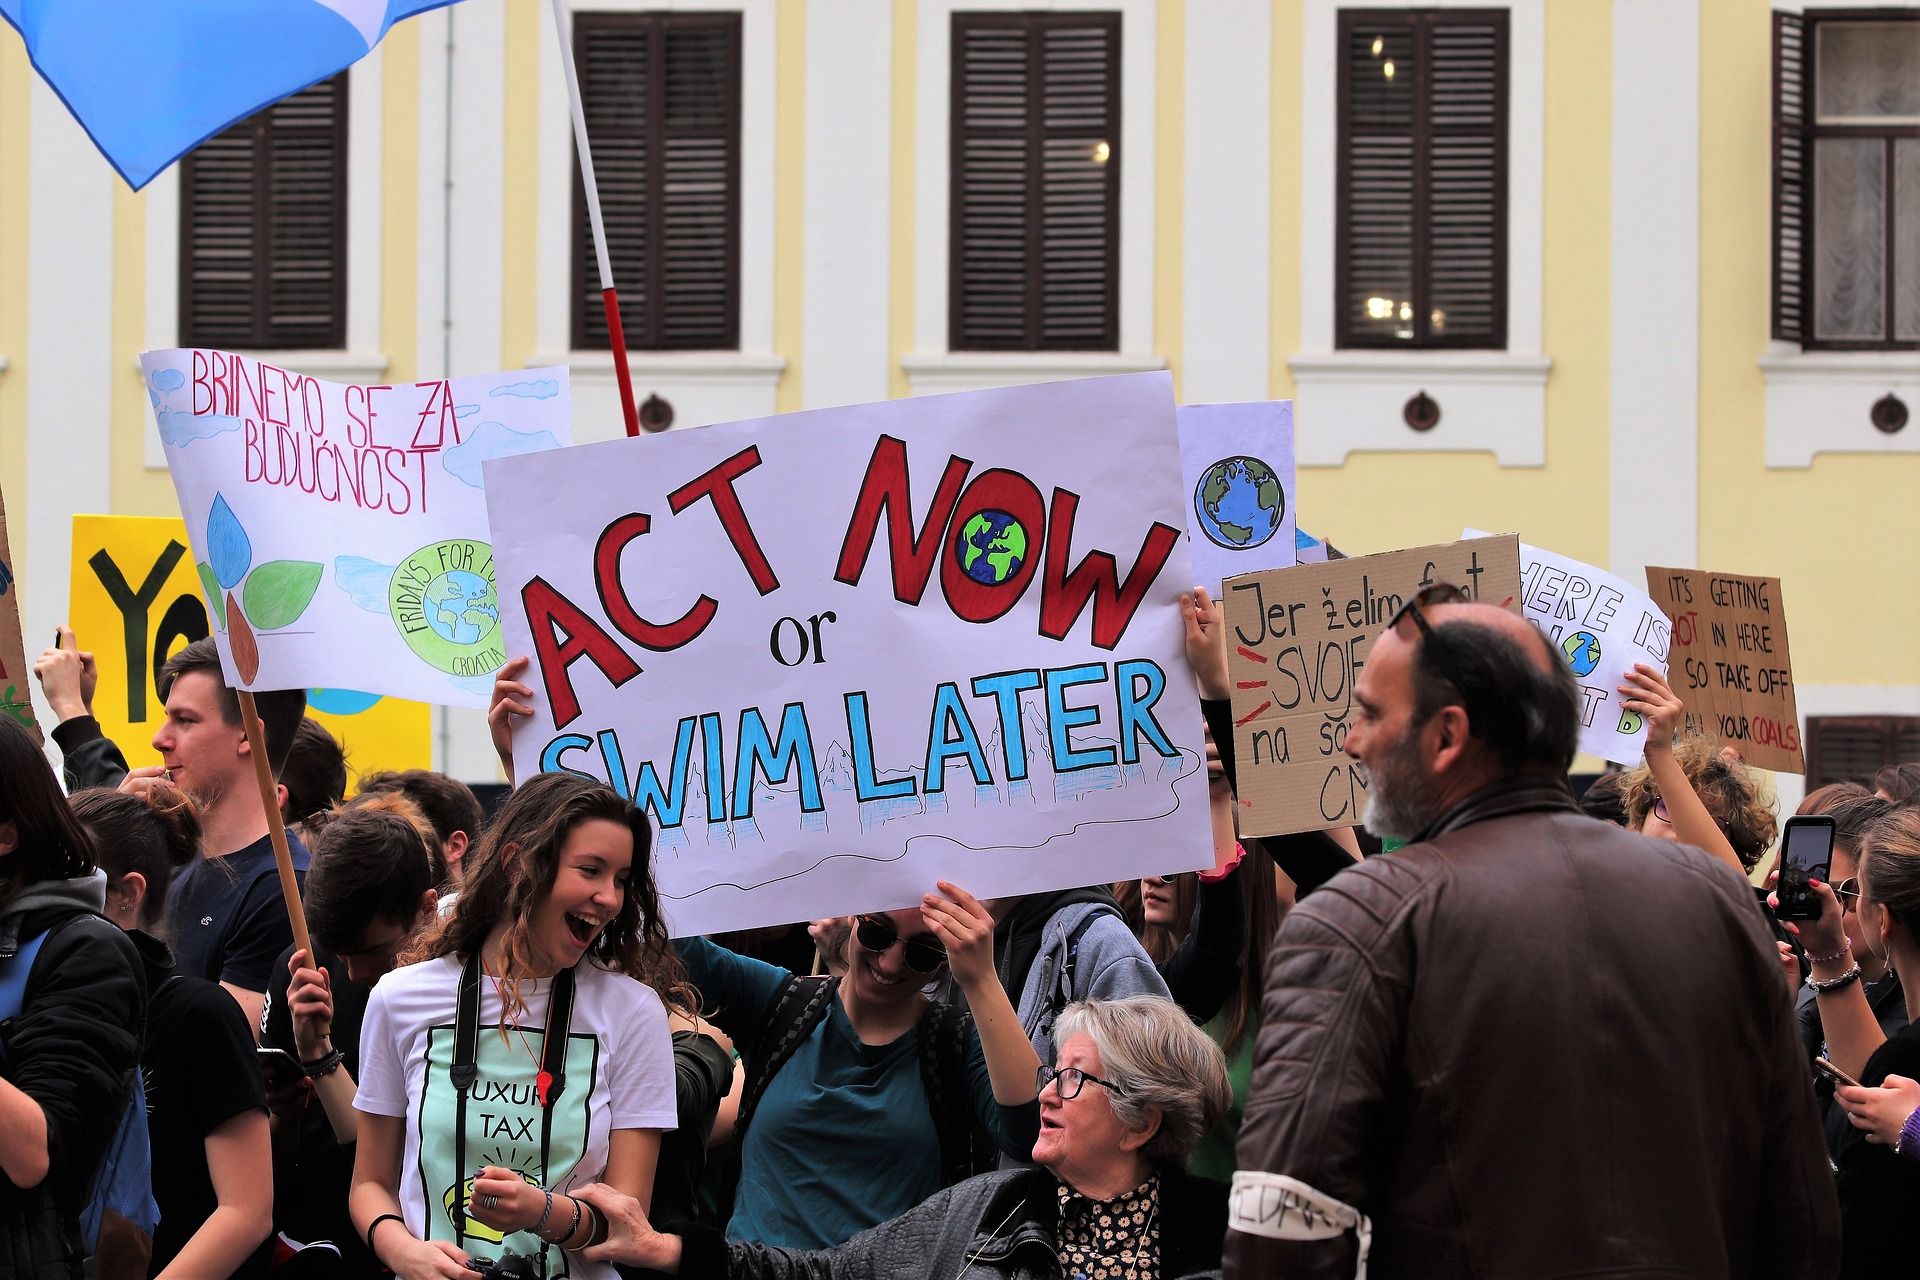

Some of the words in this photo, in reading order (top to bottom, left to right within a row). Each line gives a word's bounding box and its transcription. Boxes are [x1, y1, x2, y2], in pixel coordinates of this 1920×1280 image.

[193, 351, 324, 437] BRINEMO
[345, 385, 393, 450] SE
[411, 380, 461, 450] ZA
[245, 417, 440, 515] BUDUĆNOST
[397, 559, 432, 634] FRIDAYS
[437, 543, 475, 571] FOR
[520, 445, 780, 731] ACT
[834, 434, 1181, 651] NOW
[1668, 576, 1693, 603] IT'S
[1710, 578, 1770, 614] GETTING
[1232, 582, 1305, 646] Jer
[1321, 575, 1403, 631] želim
[1666, 611, 1698, 647] HOT
[1711, 622, 1727, 648] IN
[1735, 623, 1773, 653] HERE
[452, 647, 507, 676] CROATIA
[769, 609, 837, 668] or
[1633, 610, 1671, 664] IS
[1685, 657, 1709, 689] SO
[1715, 662, 1753, 693] TAKE
[1758, 668, 1789, 701] OFF
[539, 702, 825, 829] SWIM
[844, 660, 1182, 803] LATER
[1252, 727, 1290, 765] na
[1716, 712, 1752, 740] YOUR
[1752, 716, 1798, 752] COALS
[480, 1113, 536, 1142] TAX
[501, 1270, 520, 1280] Nikon
